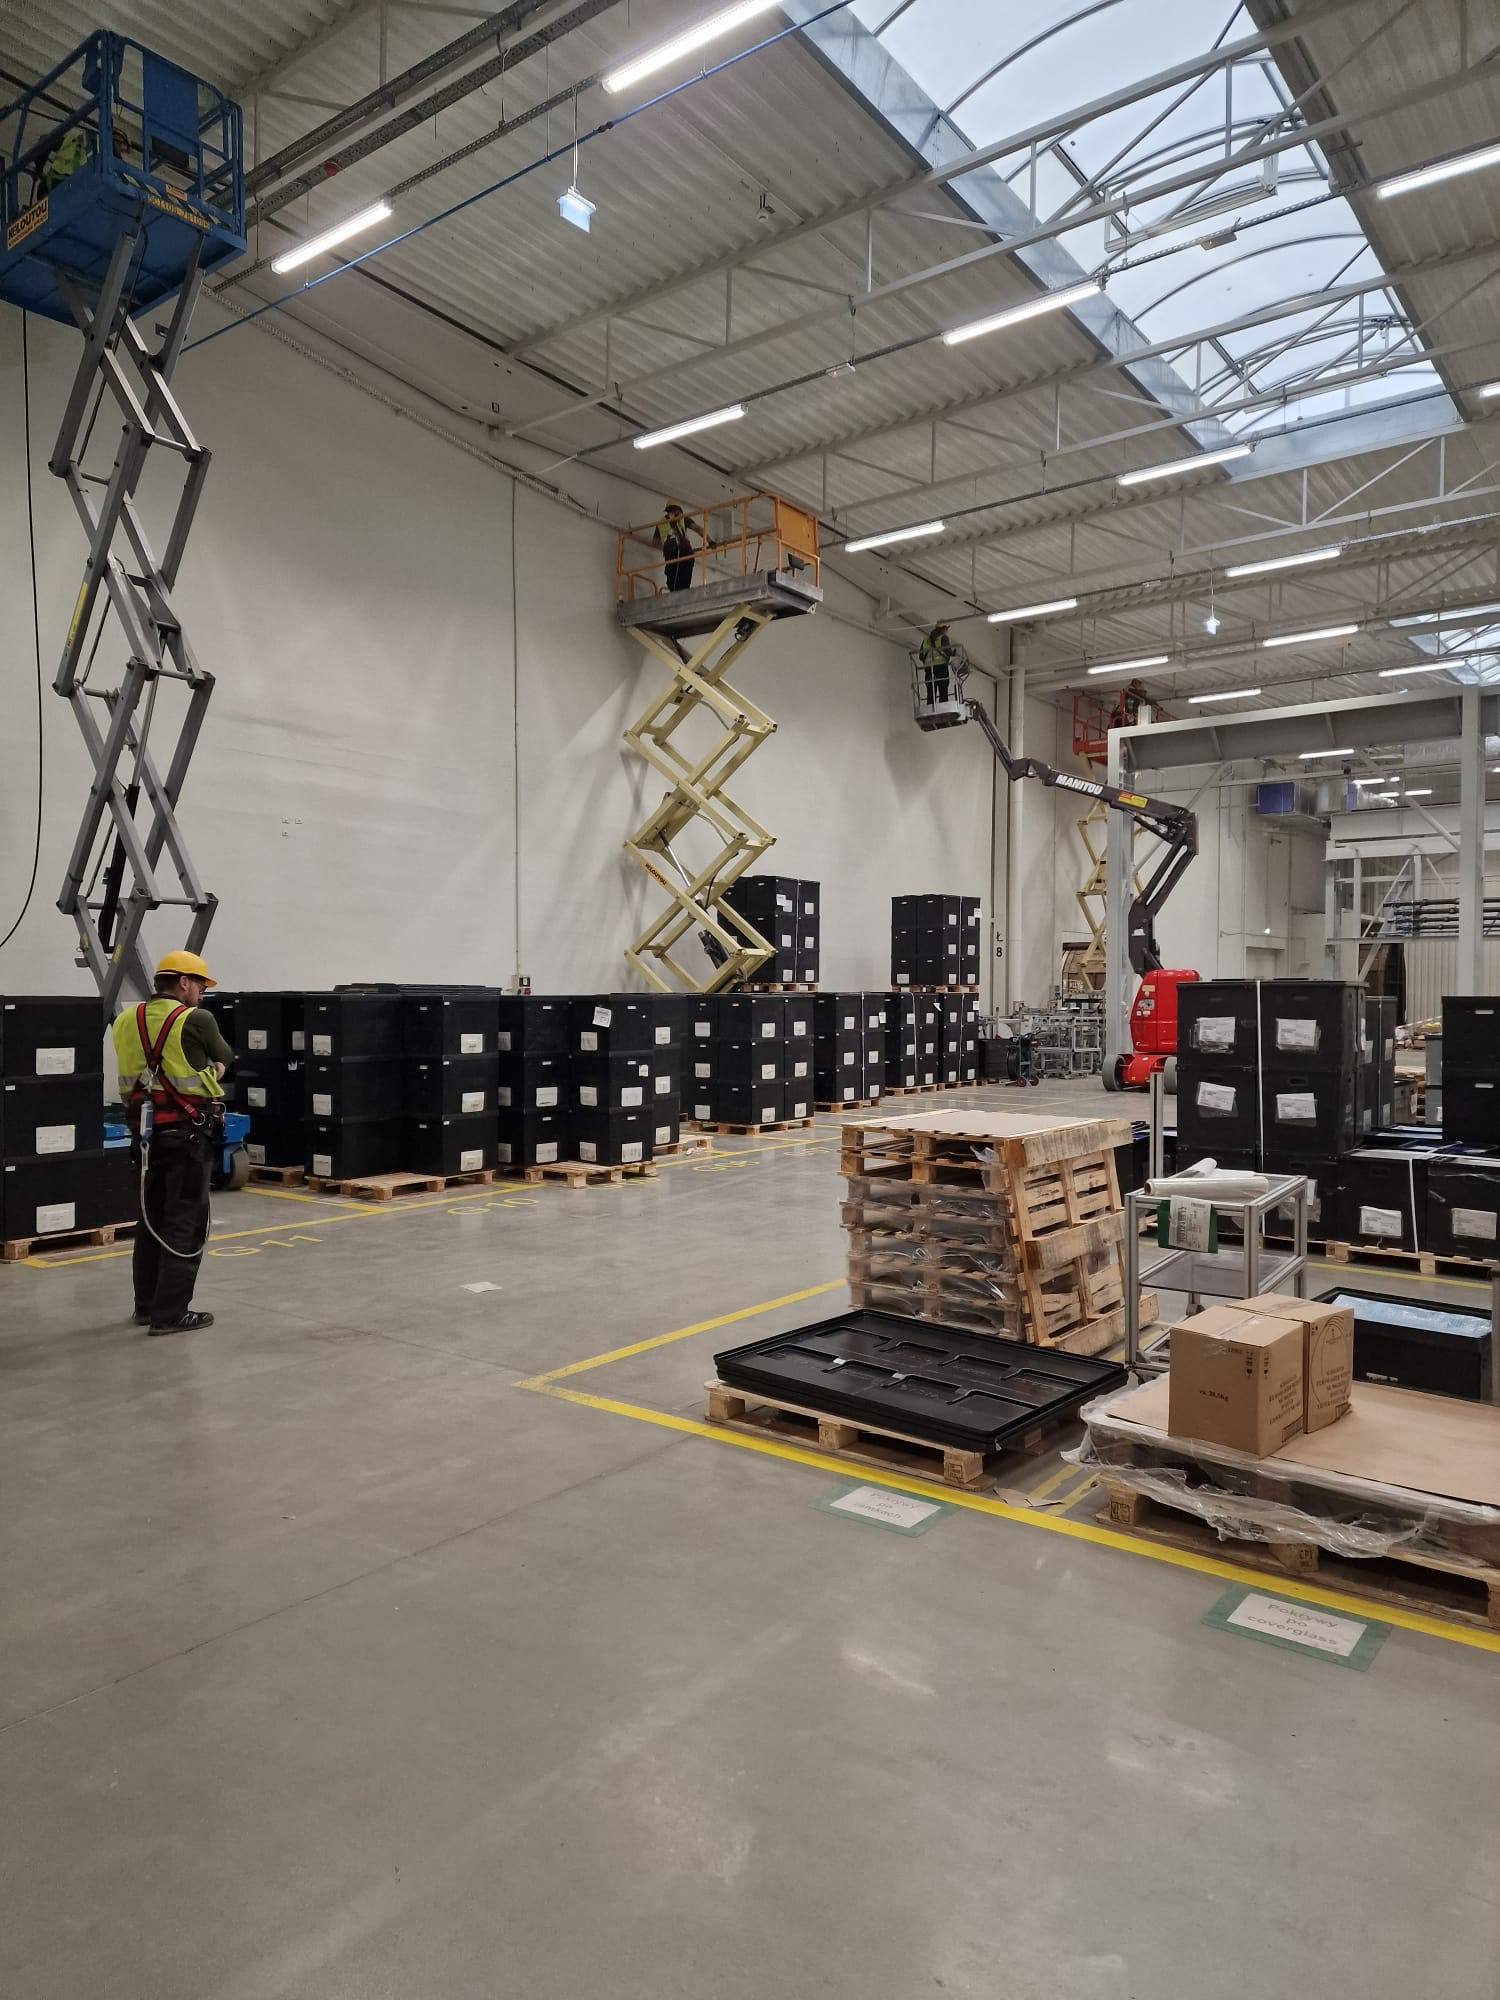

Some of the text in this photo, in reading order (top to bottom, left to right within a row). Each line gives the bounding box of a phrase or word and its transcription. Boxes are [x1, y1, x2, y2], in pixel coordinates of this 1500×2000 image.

[1055, 774, 1104, 795] MANITOU
[996, 946, 1003, 957] 8
[447, 1197, 540, 1215] G10
[207, 1235, 324, 1257] G11
[1268, 1603, 1338, 1628] Pokrywy
[1285, 1617, 1308, 1628] po
[1247, 1615, 1338, 1645] coverglass
